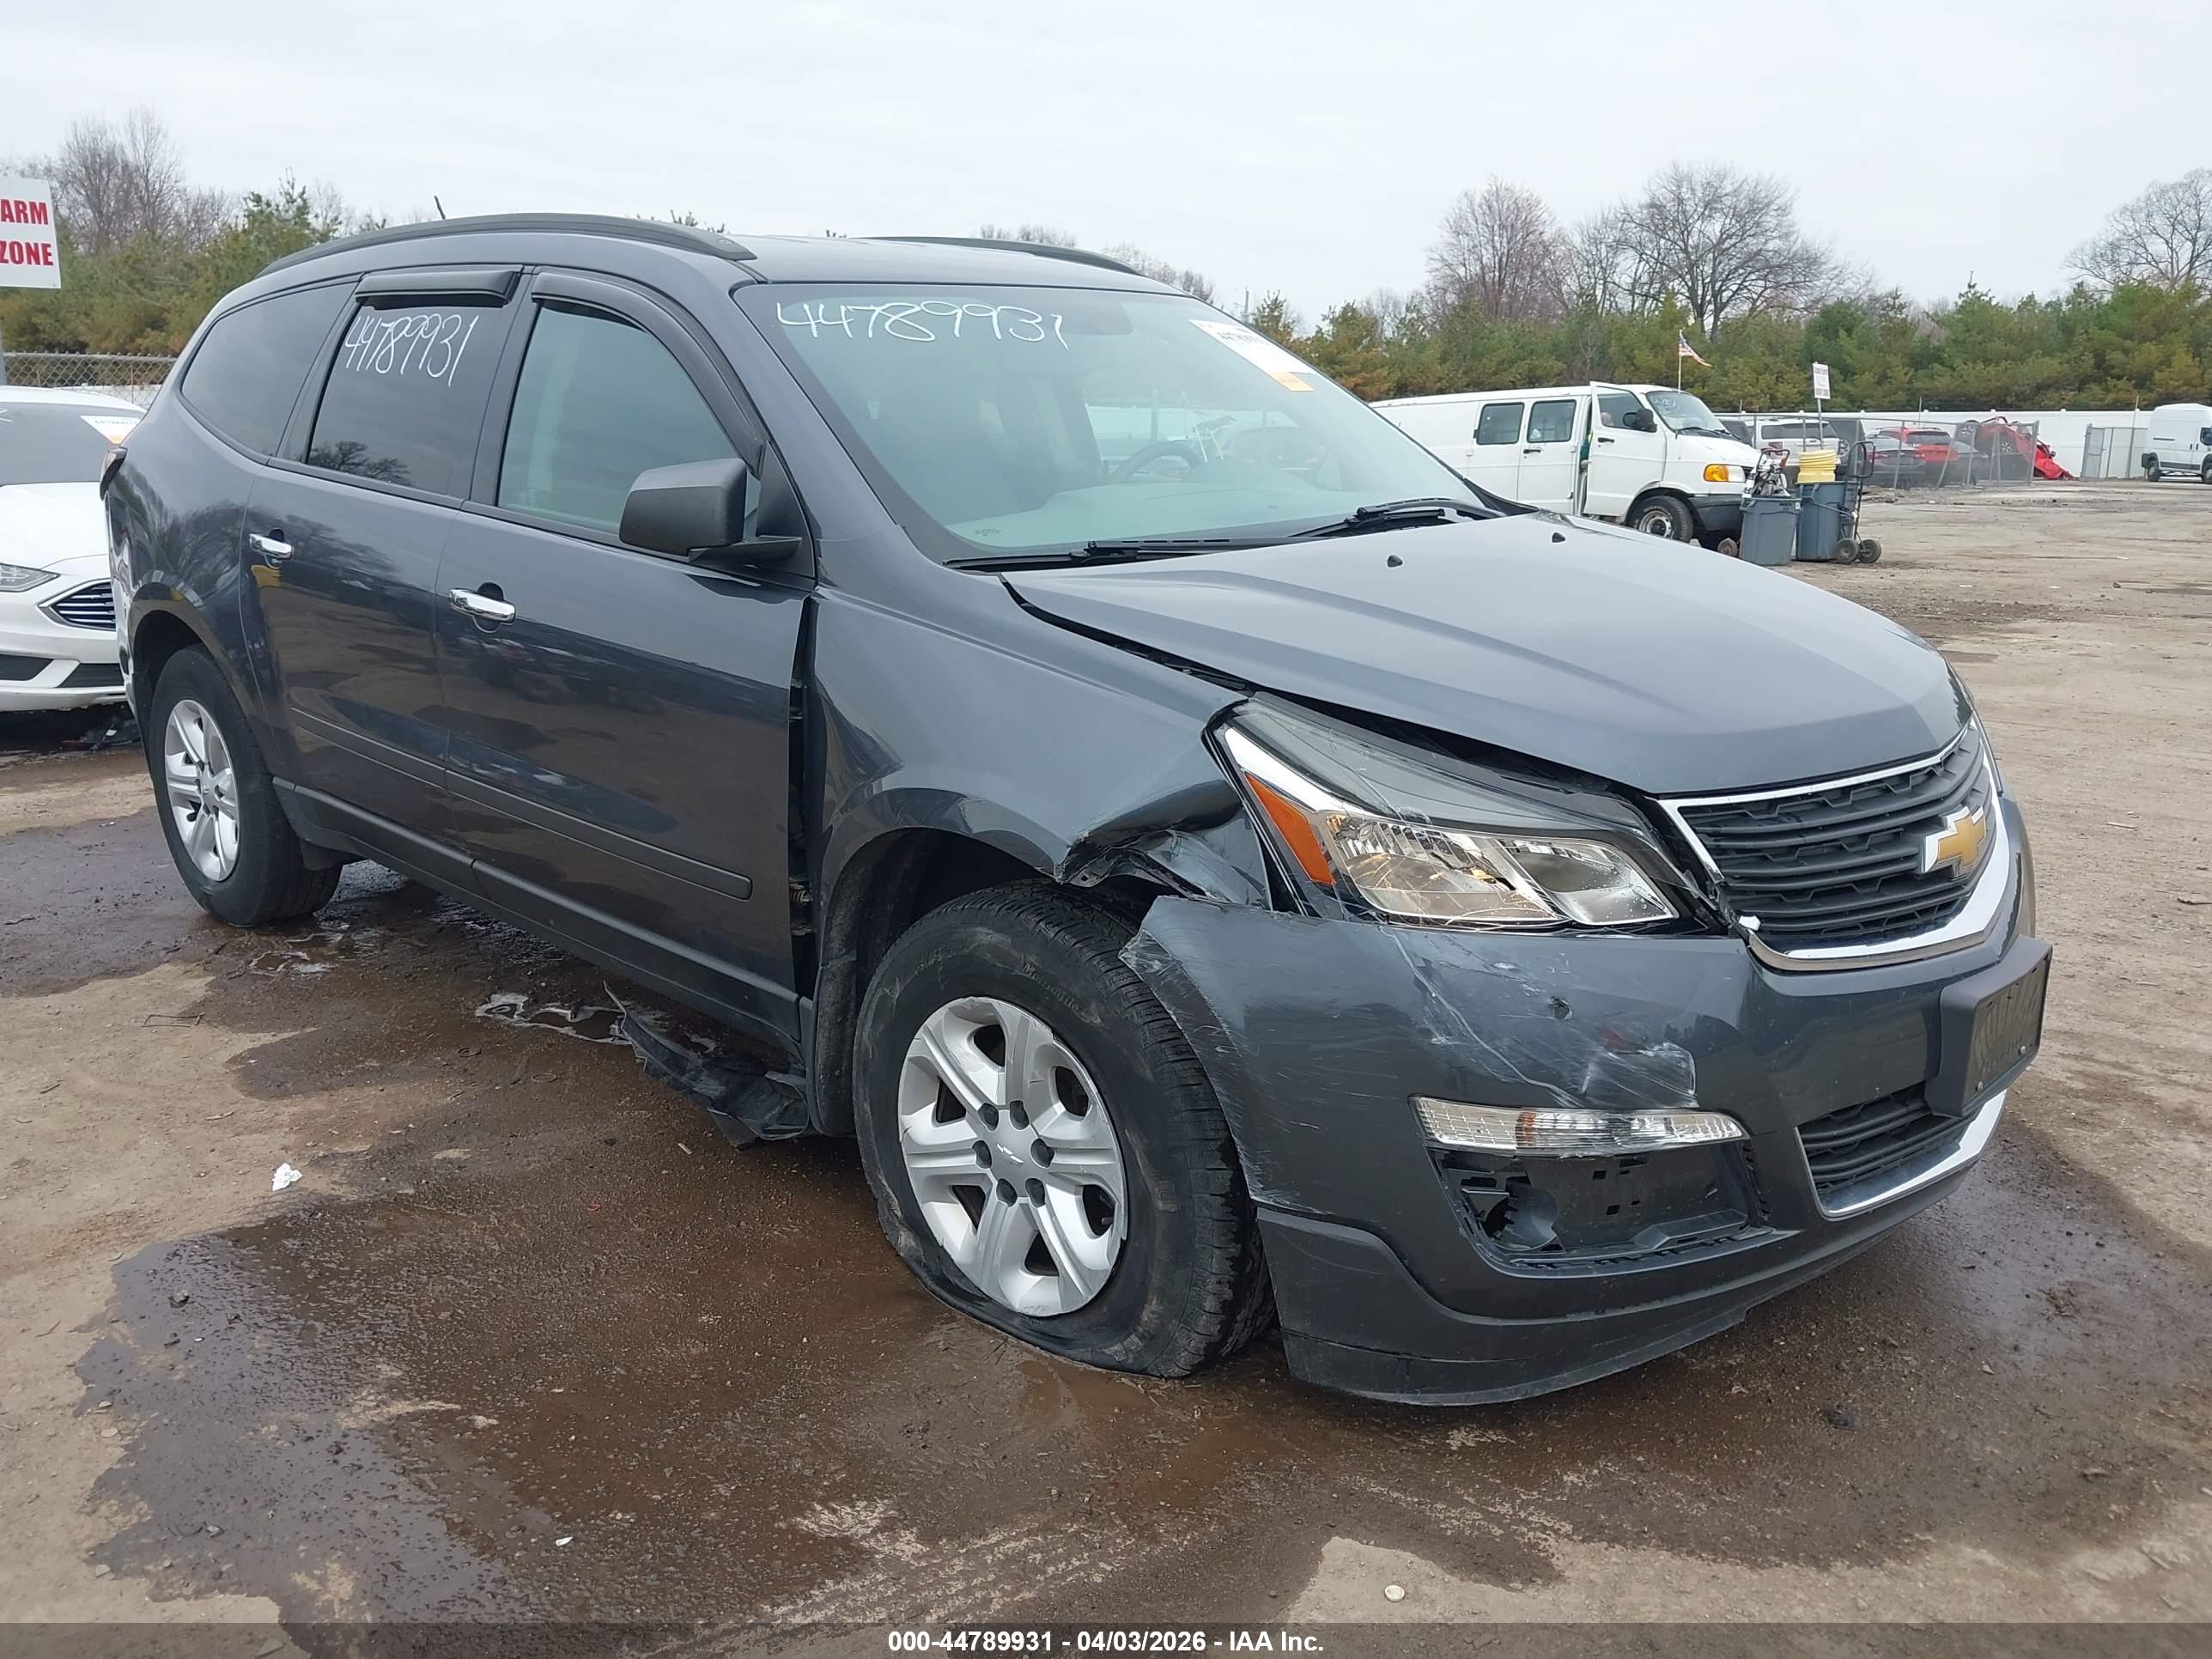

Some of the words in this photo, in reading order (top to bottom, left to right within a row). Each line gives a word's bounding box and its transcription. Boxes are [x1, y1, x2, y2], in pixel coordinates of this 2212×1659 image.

[0, 198, 48, 225] ARM
[0, 240, 53, 266] ZONE
[776, 301, 1070, 349] 44789931
[344, 313, 479, 387] 44789931
